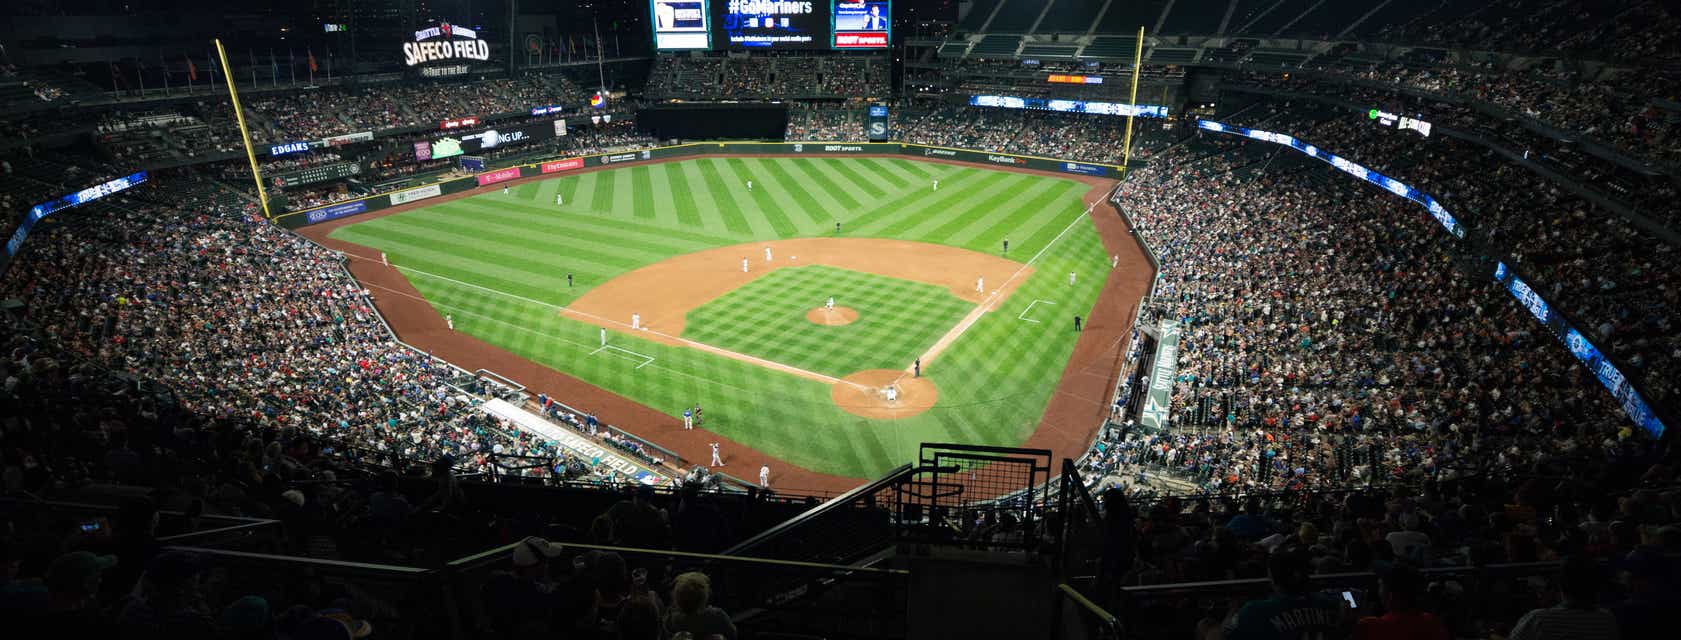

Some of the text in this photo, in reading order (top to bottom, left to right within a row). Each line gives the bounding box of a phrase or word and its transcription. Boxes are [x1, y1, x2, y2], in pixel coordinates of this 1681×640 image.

[403, 40, 489, 66] SAFECO FIELD
[988, 154, 1015, 164] KeyBank
[1599, 361, 1625, 386] TRUE
[565, 435, 638, 475] SAFECO FIELD
